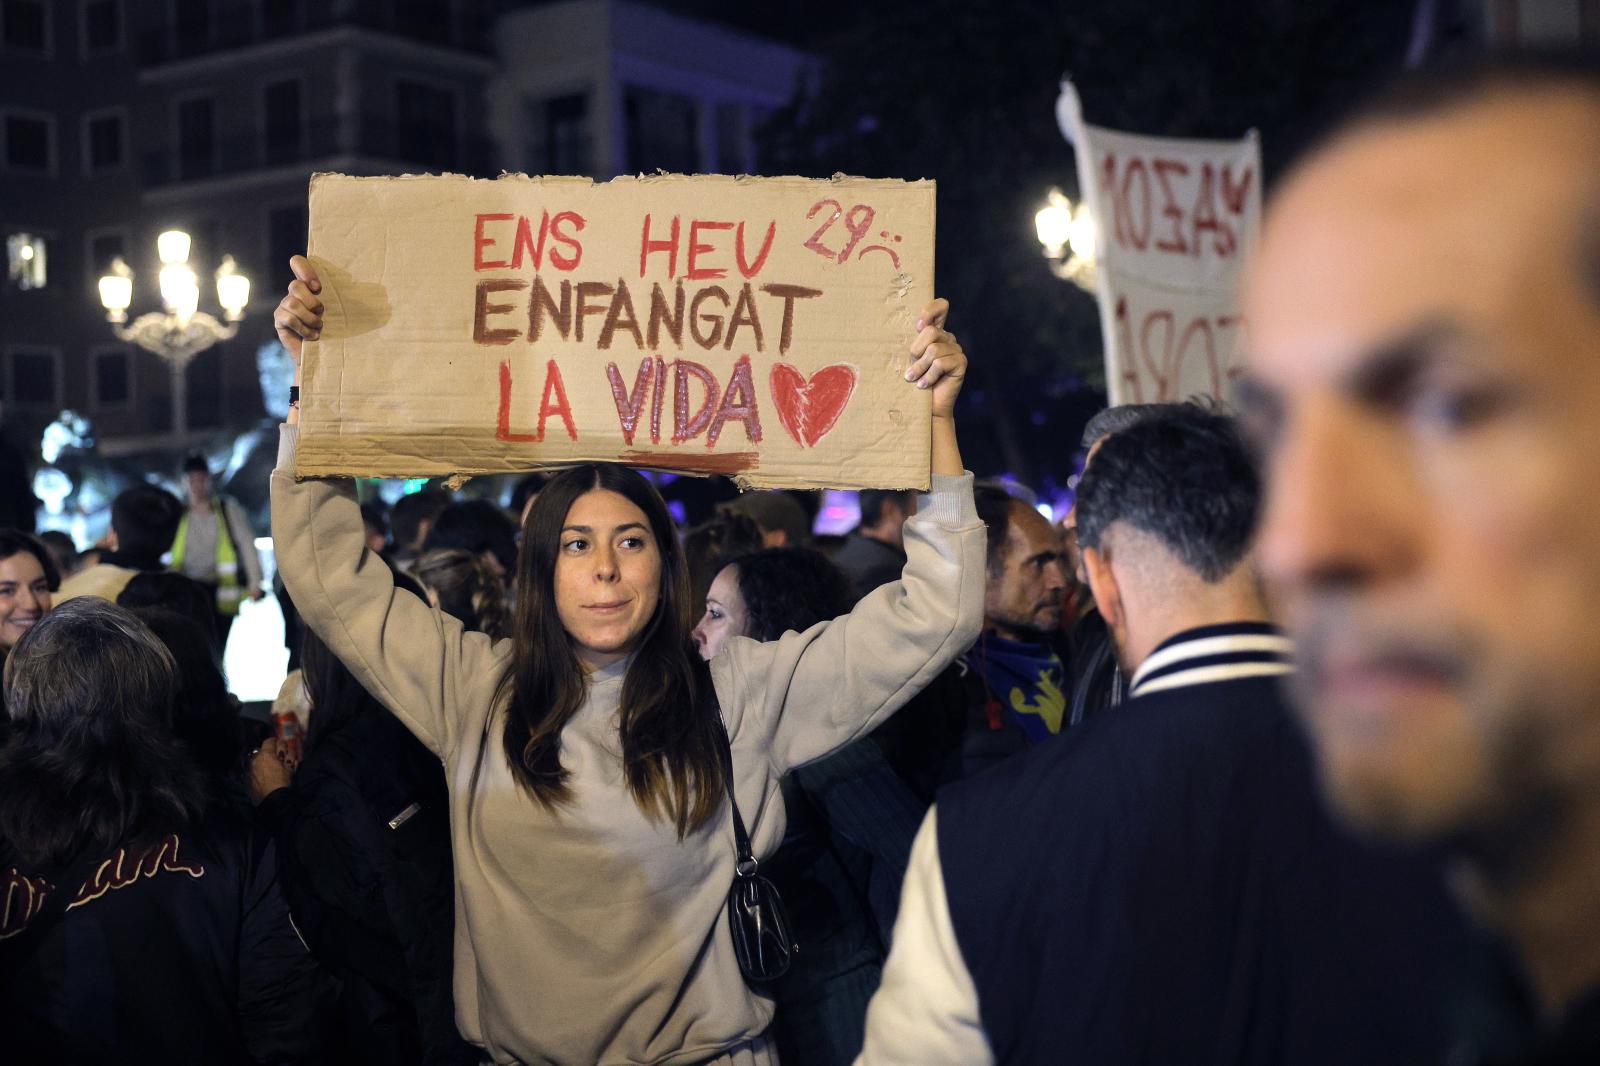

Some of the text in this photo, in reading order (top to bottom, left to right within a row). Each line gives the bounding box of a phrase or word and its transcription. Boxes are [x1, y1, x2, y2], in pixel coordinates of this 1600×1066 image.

[474, 210, 777, 280] ENS HEU
[803, 198, 876, 265] 29
[473, 275, 824, 354] ENFANGAT
[495, 354, 764, 448] LA VIDA
